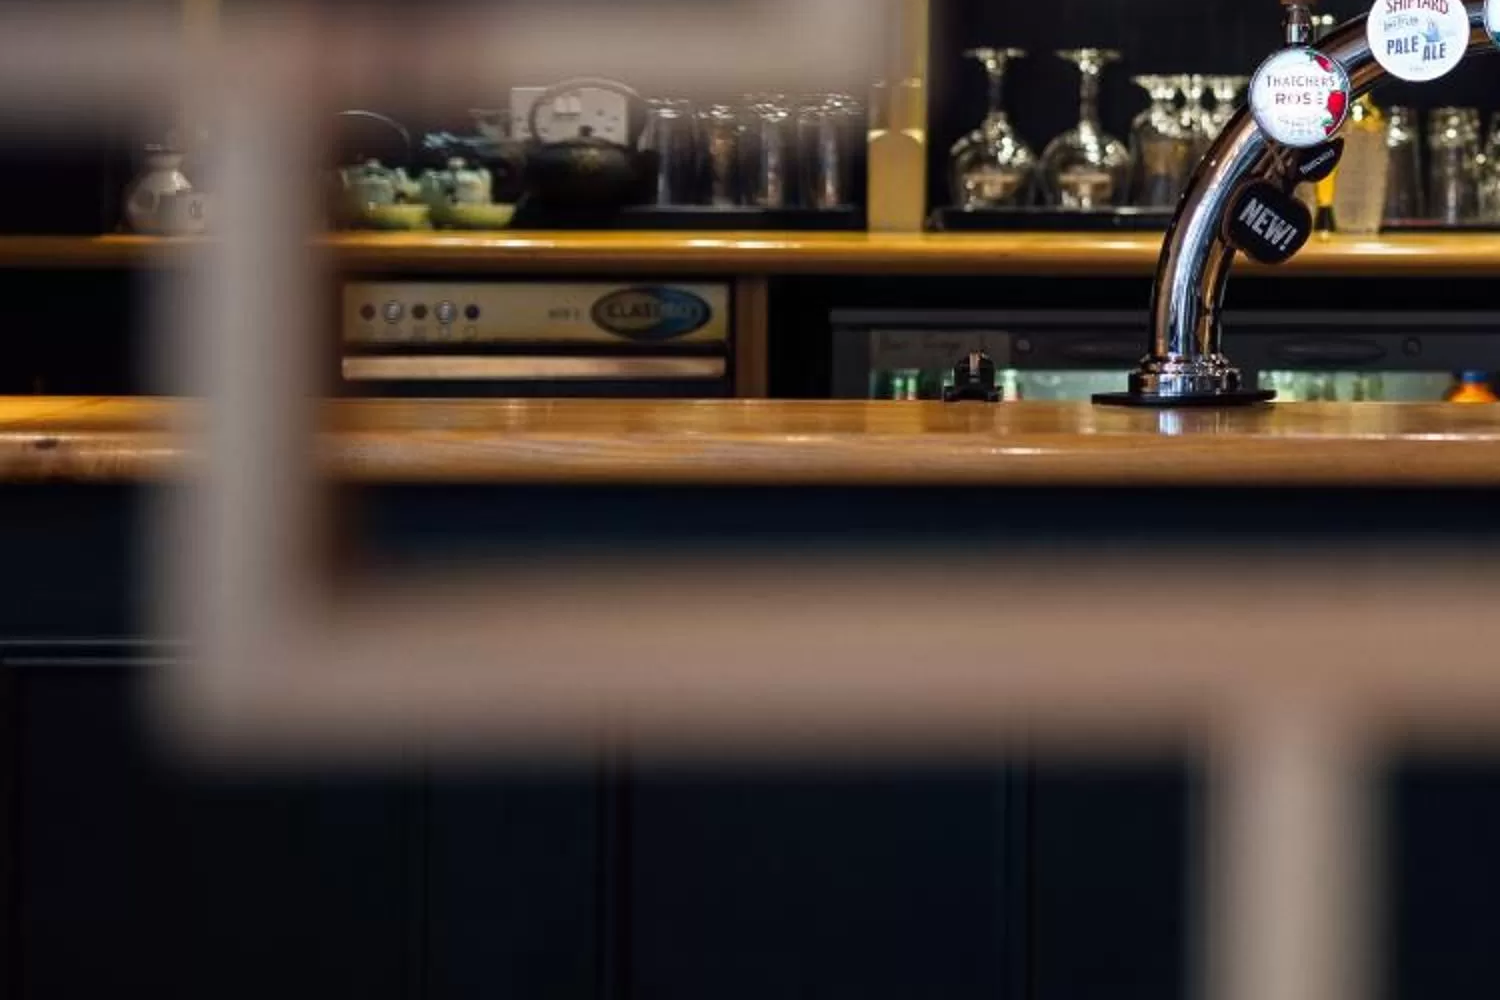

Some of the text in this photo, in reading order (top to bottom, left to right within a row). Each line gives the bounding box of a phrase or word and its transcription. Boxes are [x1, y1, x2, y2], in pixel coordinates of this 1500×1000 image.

[1386, 35, 1447, 61] PALE ALE
[1266, 75, 1335, 88] THATCHERS
[1239, 197, 1298, 251] NEW!
